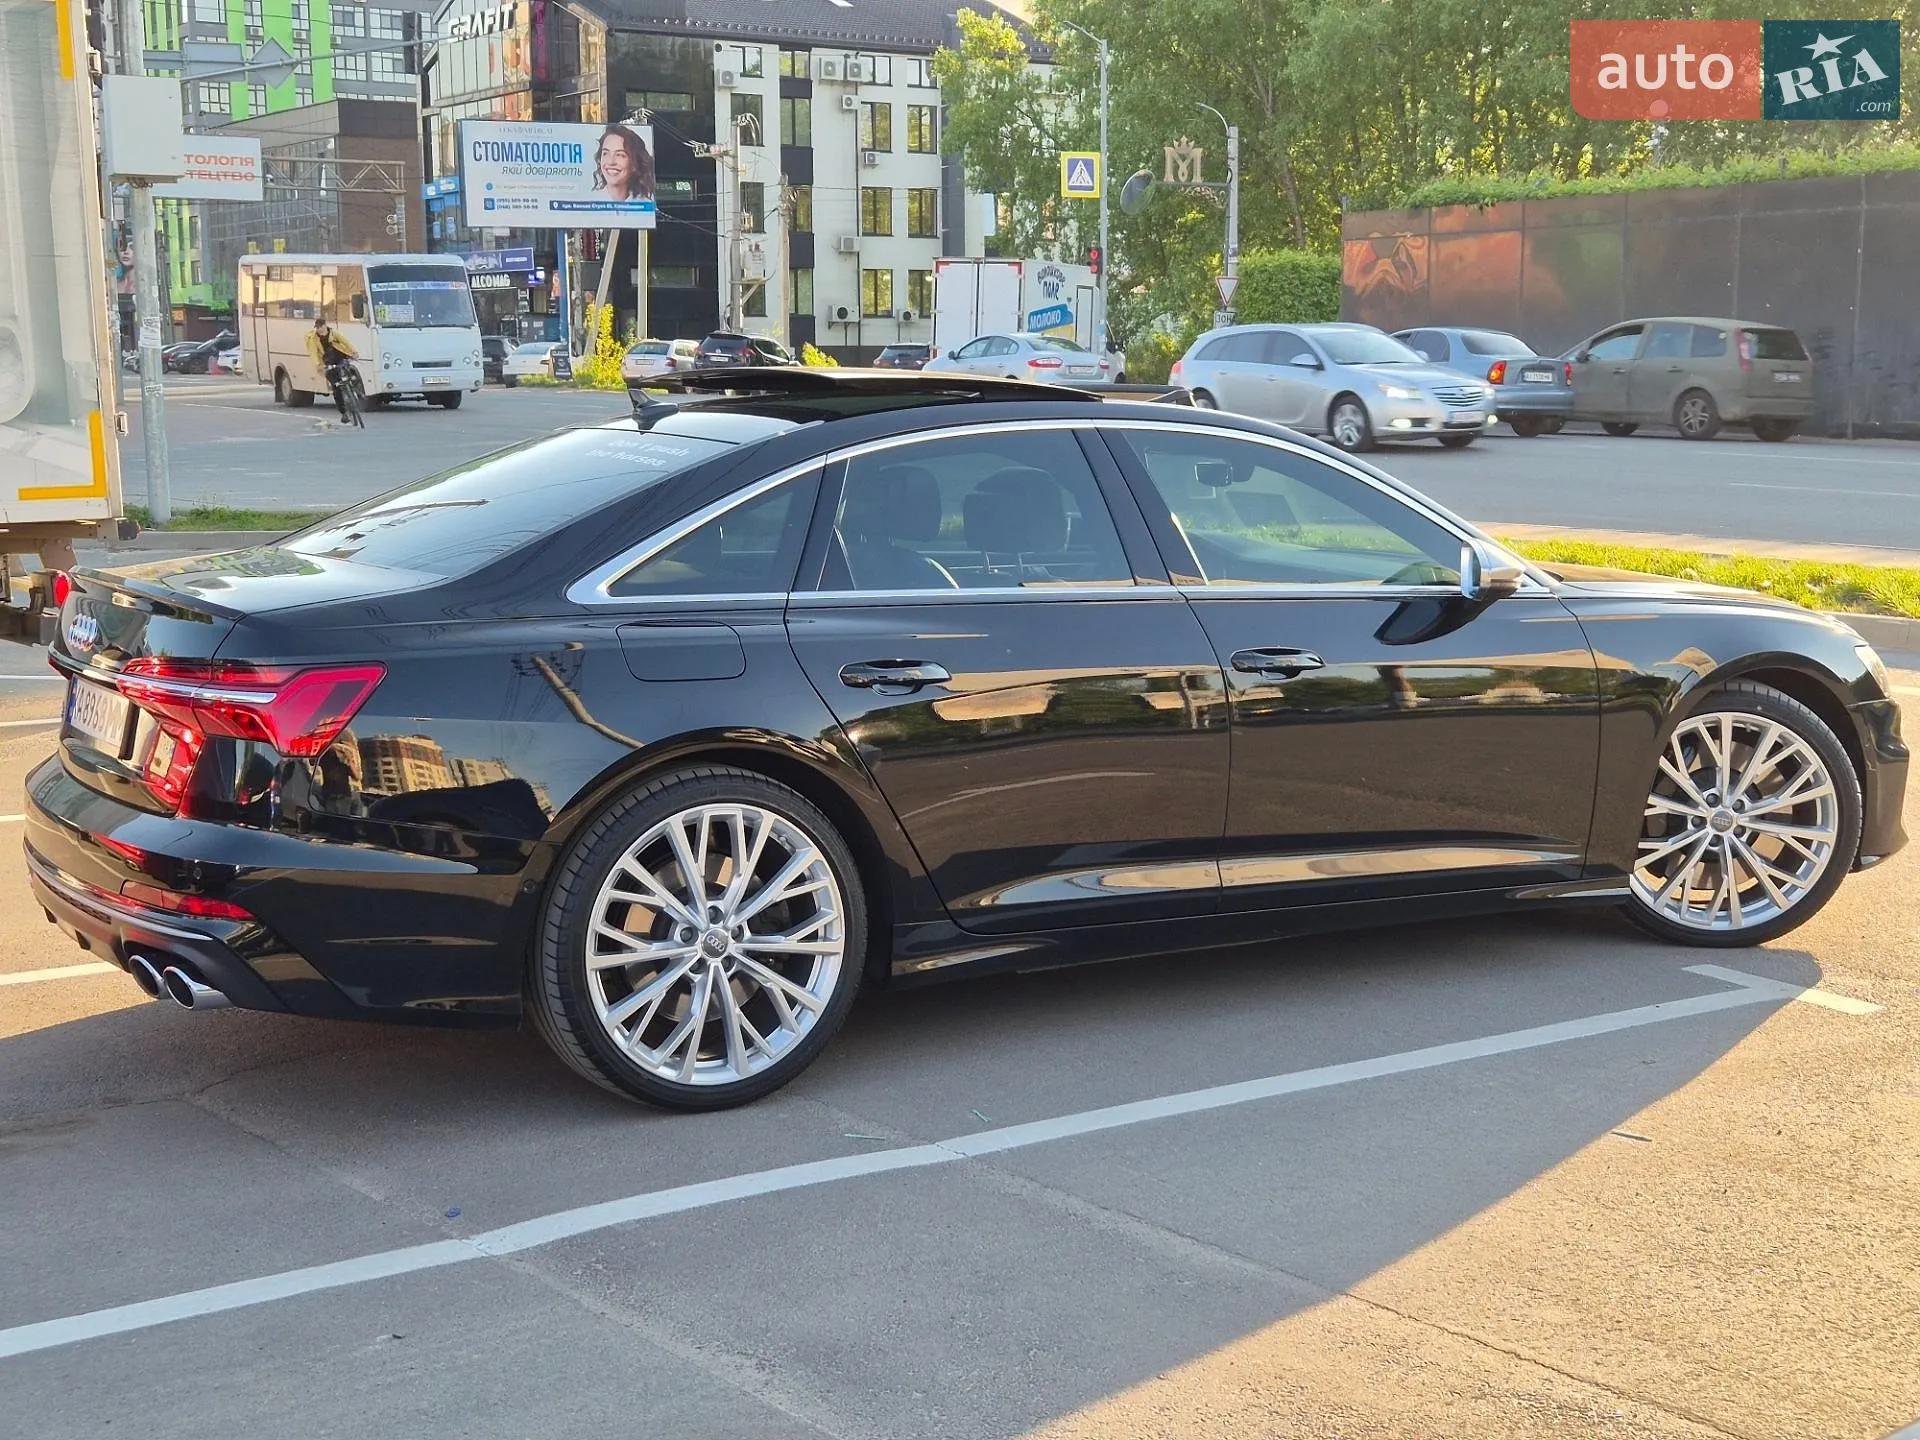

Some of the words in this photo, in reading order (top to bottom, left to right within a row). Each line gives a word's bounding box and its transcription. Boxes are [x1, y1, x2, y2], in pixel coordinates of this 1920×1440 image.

[448, 3, 514, 40] GRAFIT
[184, 154, 255, 166] ТОЛОГІЯ
[472, 140, 583, 163] СТОМАТОЛОГІЯ
[185, 169, 256, 181] ТЕЦТВО
[525, 163, 583, 178] довіряють
[1029, 309, 1061, 330] МОЛОКО
